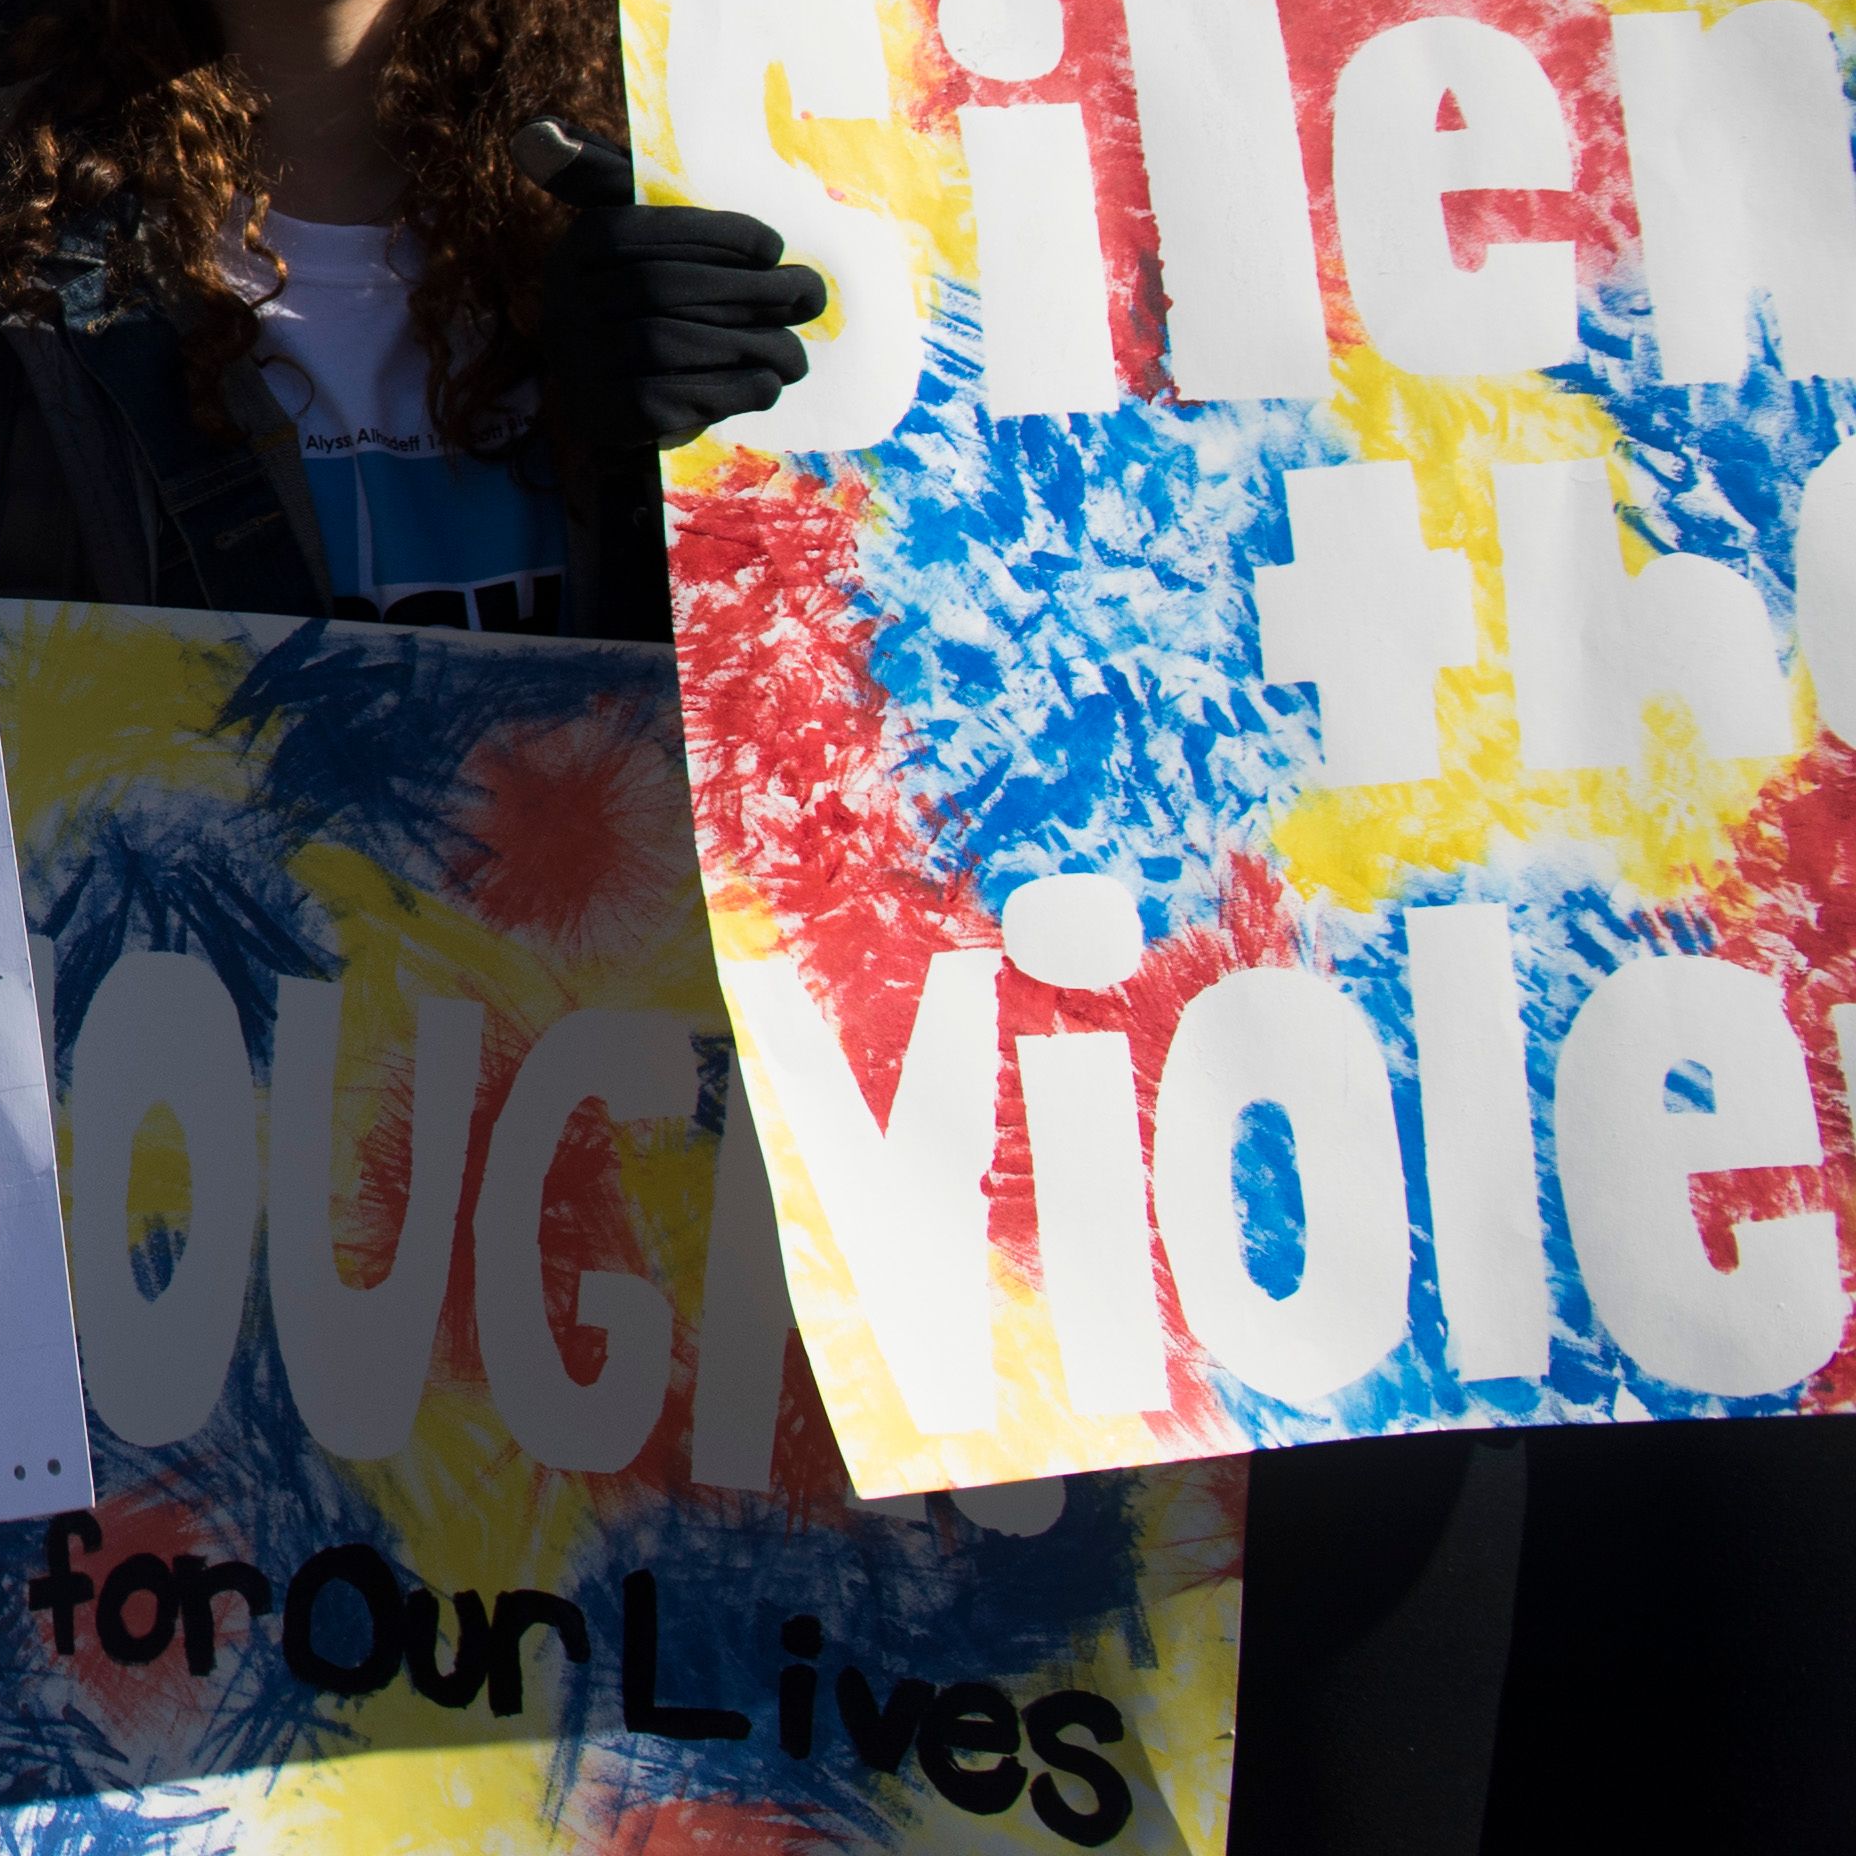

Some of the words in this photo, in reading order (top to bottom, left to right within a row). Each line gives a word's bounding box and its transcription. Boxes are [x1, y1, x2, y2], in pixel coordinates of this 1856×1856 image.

[32, 1511, 271, 1676] for
[285, 1542, 585, 1715] Our
[620, 1571, 1133, 1845] Lives
